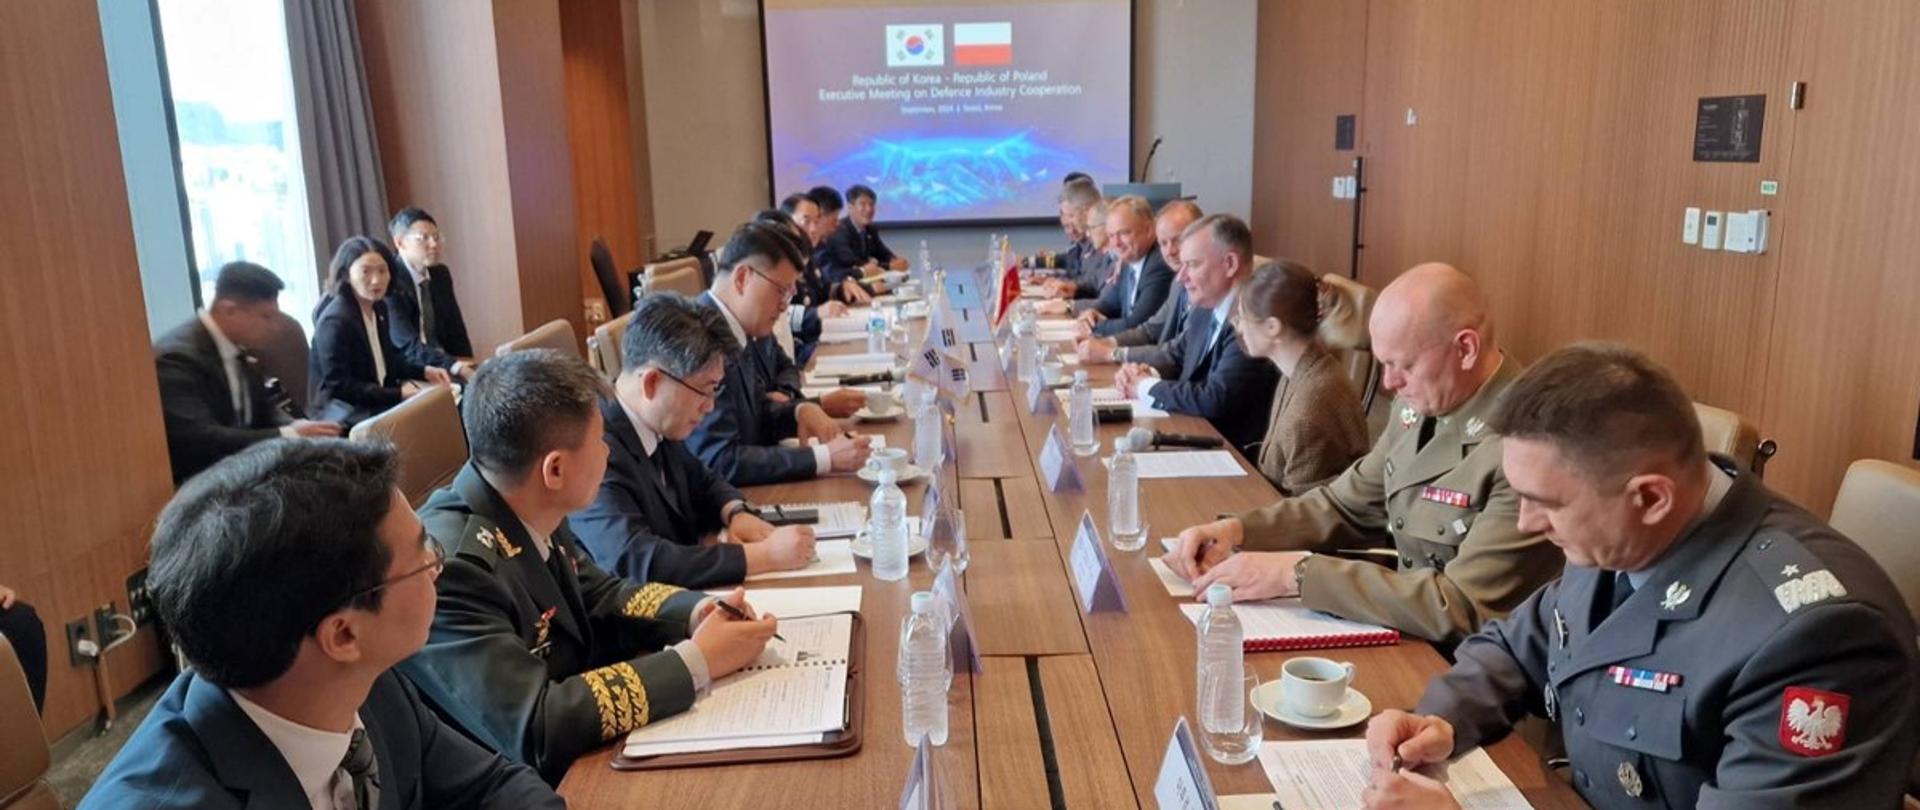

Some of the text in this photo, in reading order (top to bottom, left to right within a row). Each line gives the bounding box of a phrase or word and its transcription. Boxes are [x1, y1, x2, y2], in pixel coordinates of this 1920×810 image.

[852, 74, 897, 88] Republic
[898, 73, 910, 84] of
[912, 73, 942, 84] Korea
[953, 71, 996, 84] Republic
[999, 71, 1010, 82] of
[1013, 70, 1048, 82] Poland
[819, 84, 1082, 101] Executive Meeting on Defence Industry Cooperation
